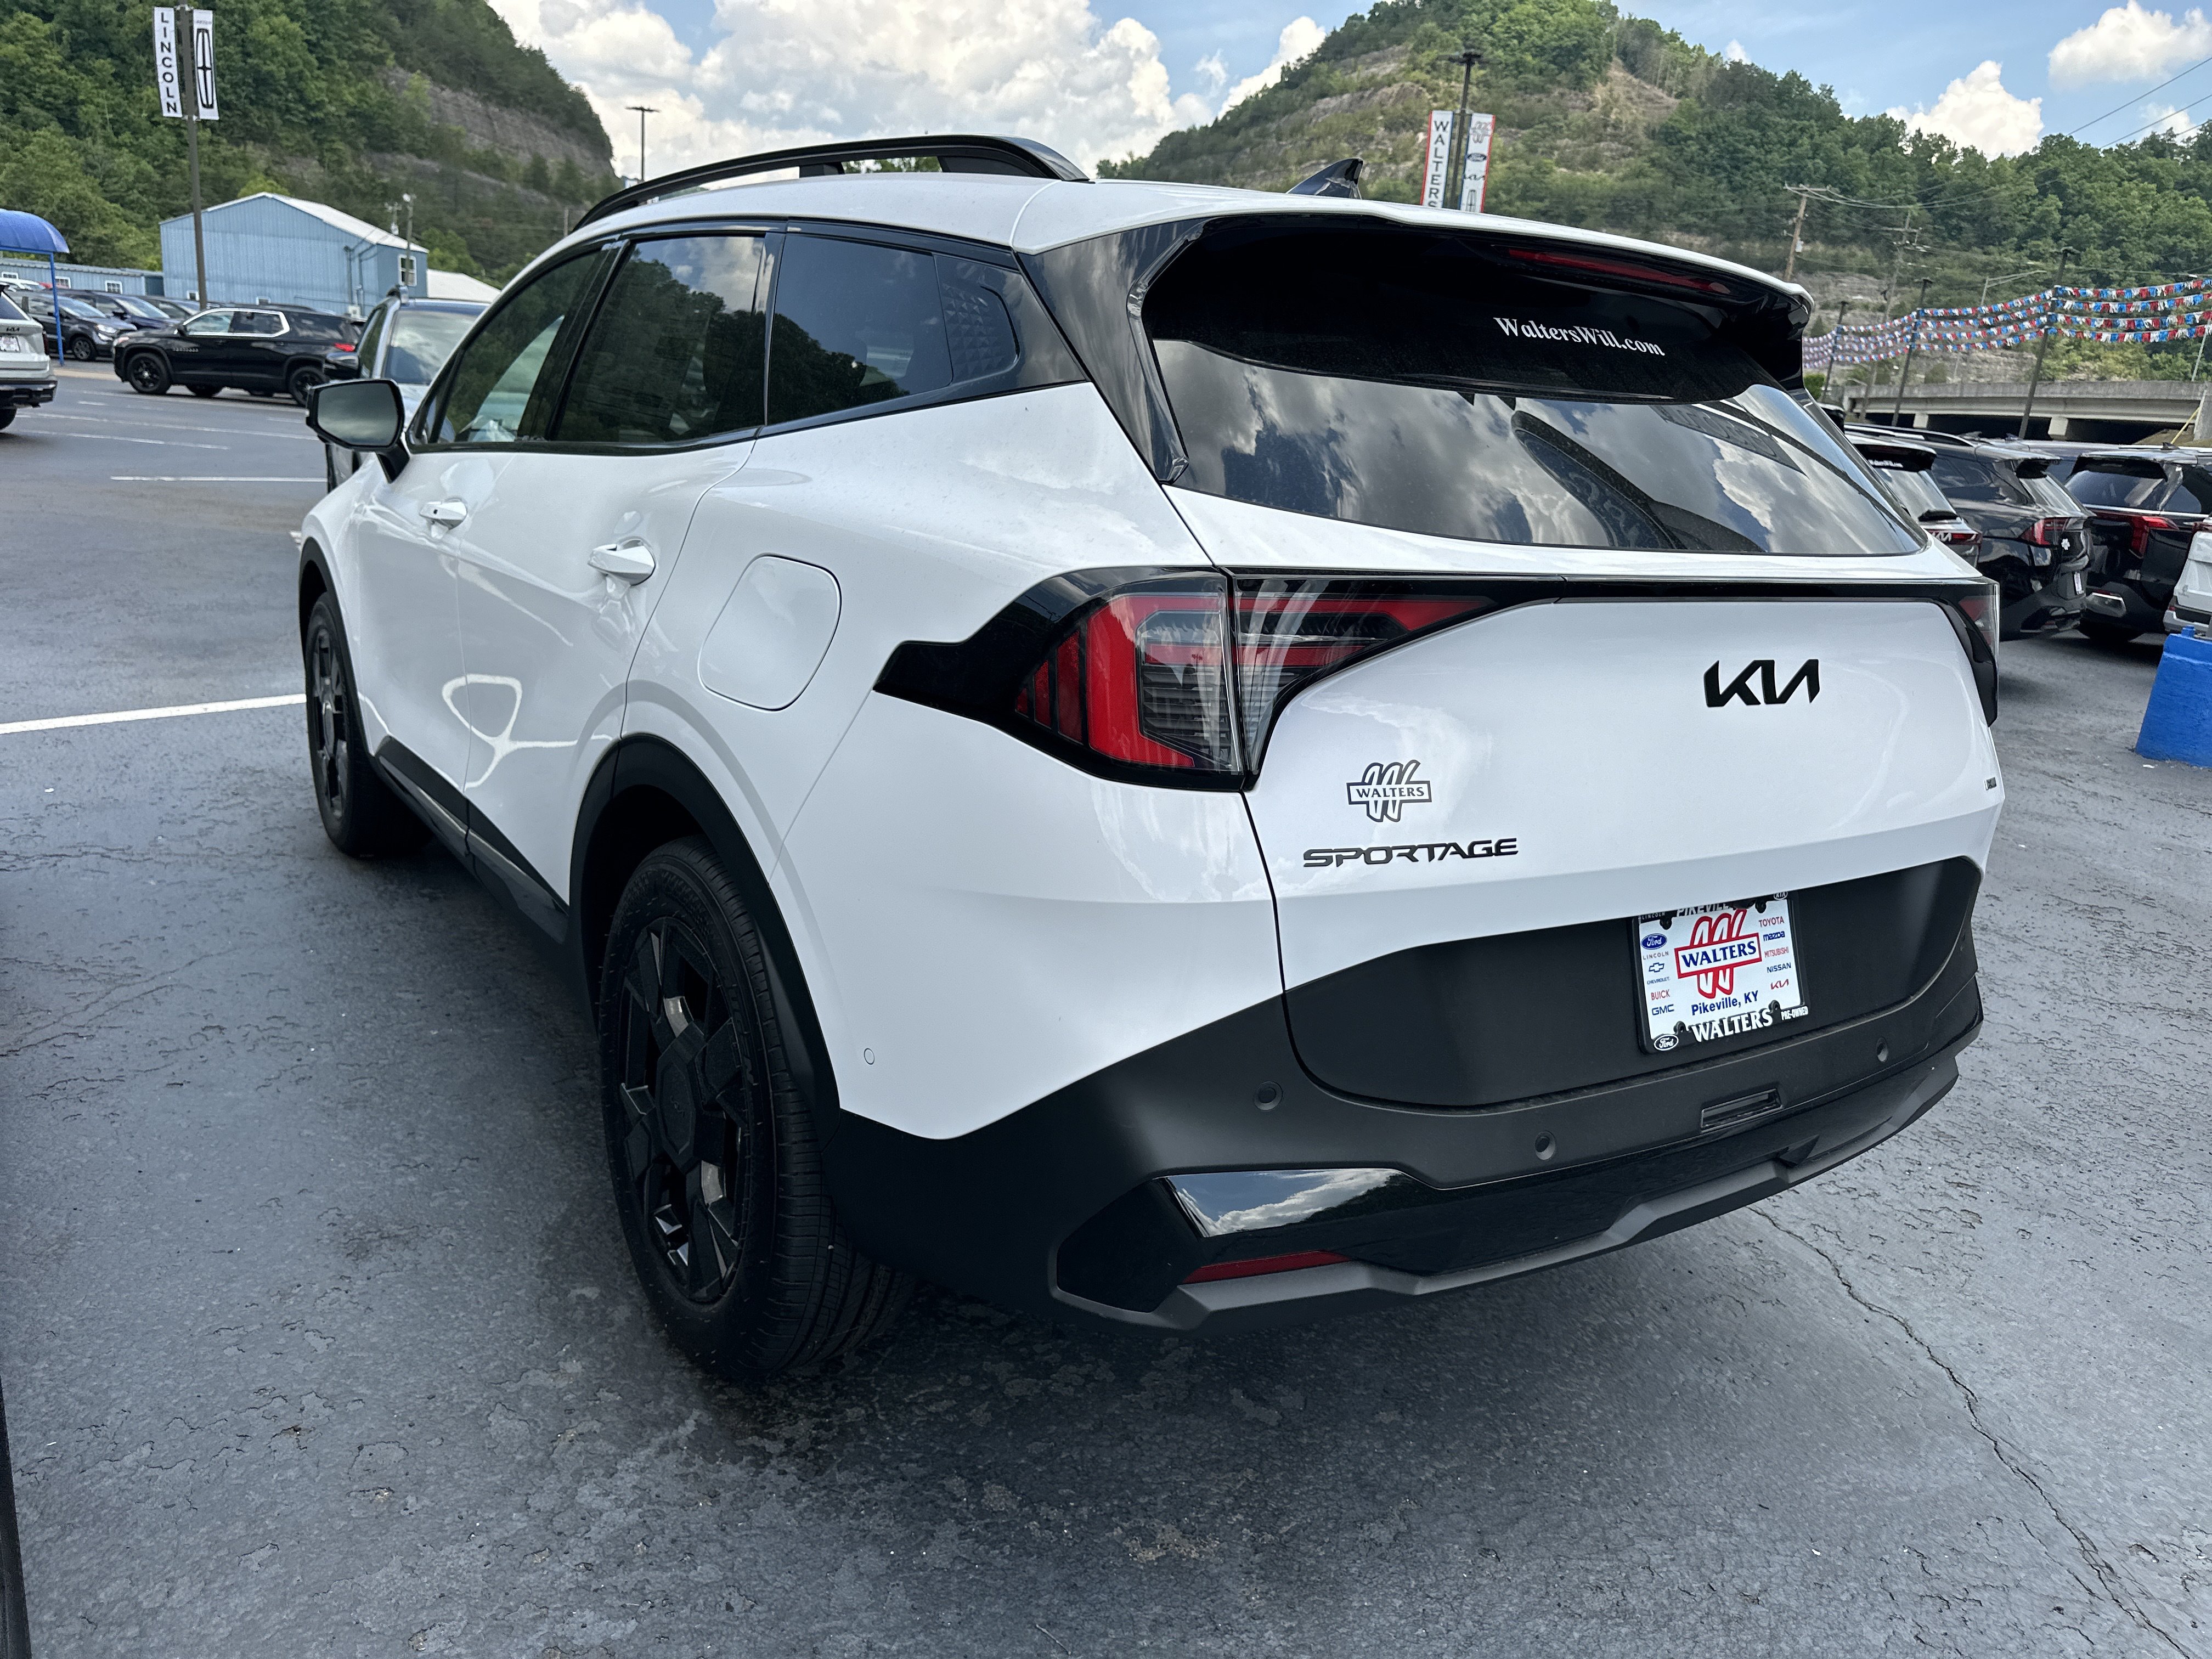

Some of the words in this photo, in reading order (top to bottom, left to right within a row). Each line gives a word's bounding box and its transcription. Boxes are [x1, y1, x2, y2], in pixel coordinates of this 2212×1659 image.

[161, 12, 177, 113] LINCOLN
[1427, 120, 1449, 207] WALTERS
[1493, 317, 1665, 356] WaltersWill.com
[1703, 659, 1820, 707] KIA
[1356, 786, 1425, 799] WALTERS
[1304, 838, 1519, 867] SPORTAGE
[1677, 903, 1731, 917] PIKEVILL
[1758, 916, 1784, 927] TOYOTA
[1646, 936, 1662, 946] Ford
[1643, 951, 1669, 960] LINCOLN
[1681, 941, 1756, 968] WALTERS
[1764, 946, 1789, 958] MITSUBISHI
[1767, 962, 1791, 973] NISSAN
[1647, 977, 1669, 985] CHEVROLET
[1770, 979, 1789, 990] KIA
[1651, 989, 1671, 1001] BUICK
[1651, 1003, 1674, 1015] GMC
[1691, 996, 1741, 1015] Pikeville,
[1743, 990, 1759, 1004] KY
[1781, 1006, 1808, 1020] PRE-OWNED
[1691, 1009, 1773, 1042] WALTERS
[1658, 1037, 1674, 1048] Ford
